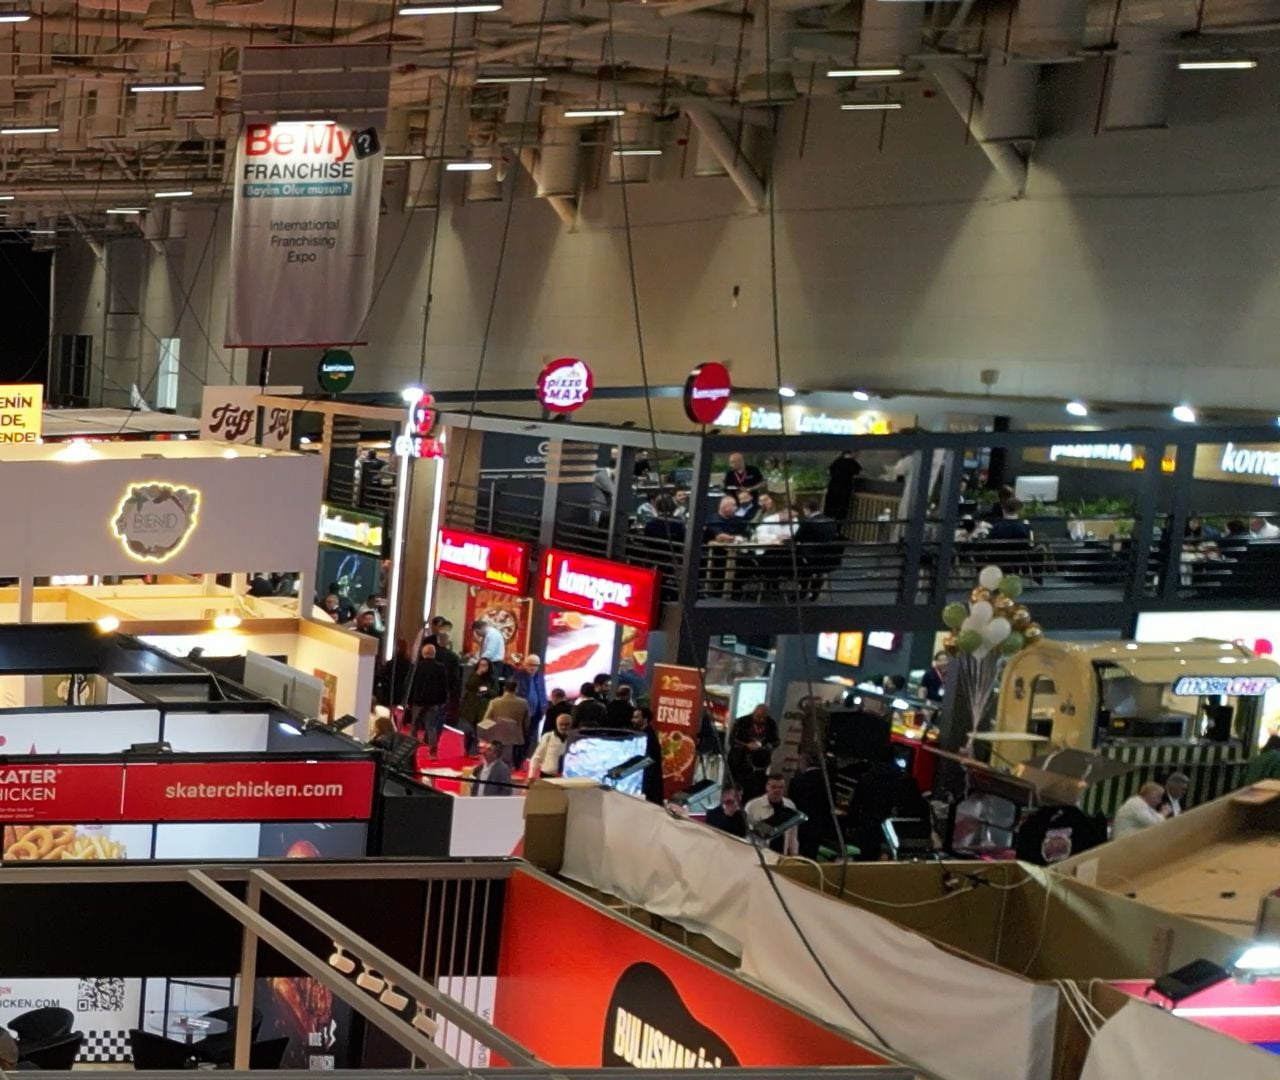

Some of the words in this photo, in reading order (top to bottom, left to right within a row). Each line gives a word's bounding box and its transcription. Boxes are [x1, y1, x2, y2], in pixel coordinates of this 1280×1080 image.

[246, 124, 294, 156] Be
[303, 124, 357, 161] My
[244, 162, 354, 180] FRANCHISE
[270, 219, 339, 231] International
[271, 235, 336, 248] Franchising
[287, 252, 317, 263] Expo
[550, 389, 583, 400] MAX
[558, 560, 632, 610] komagene
[657, 706, 692, 727] EFSANE
[165, 781, 343, 800] skaterchicken.com
